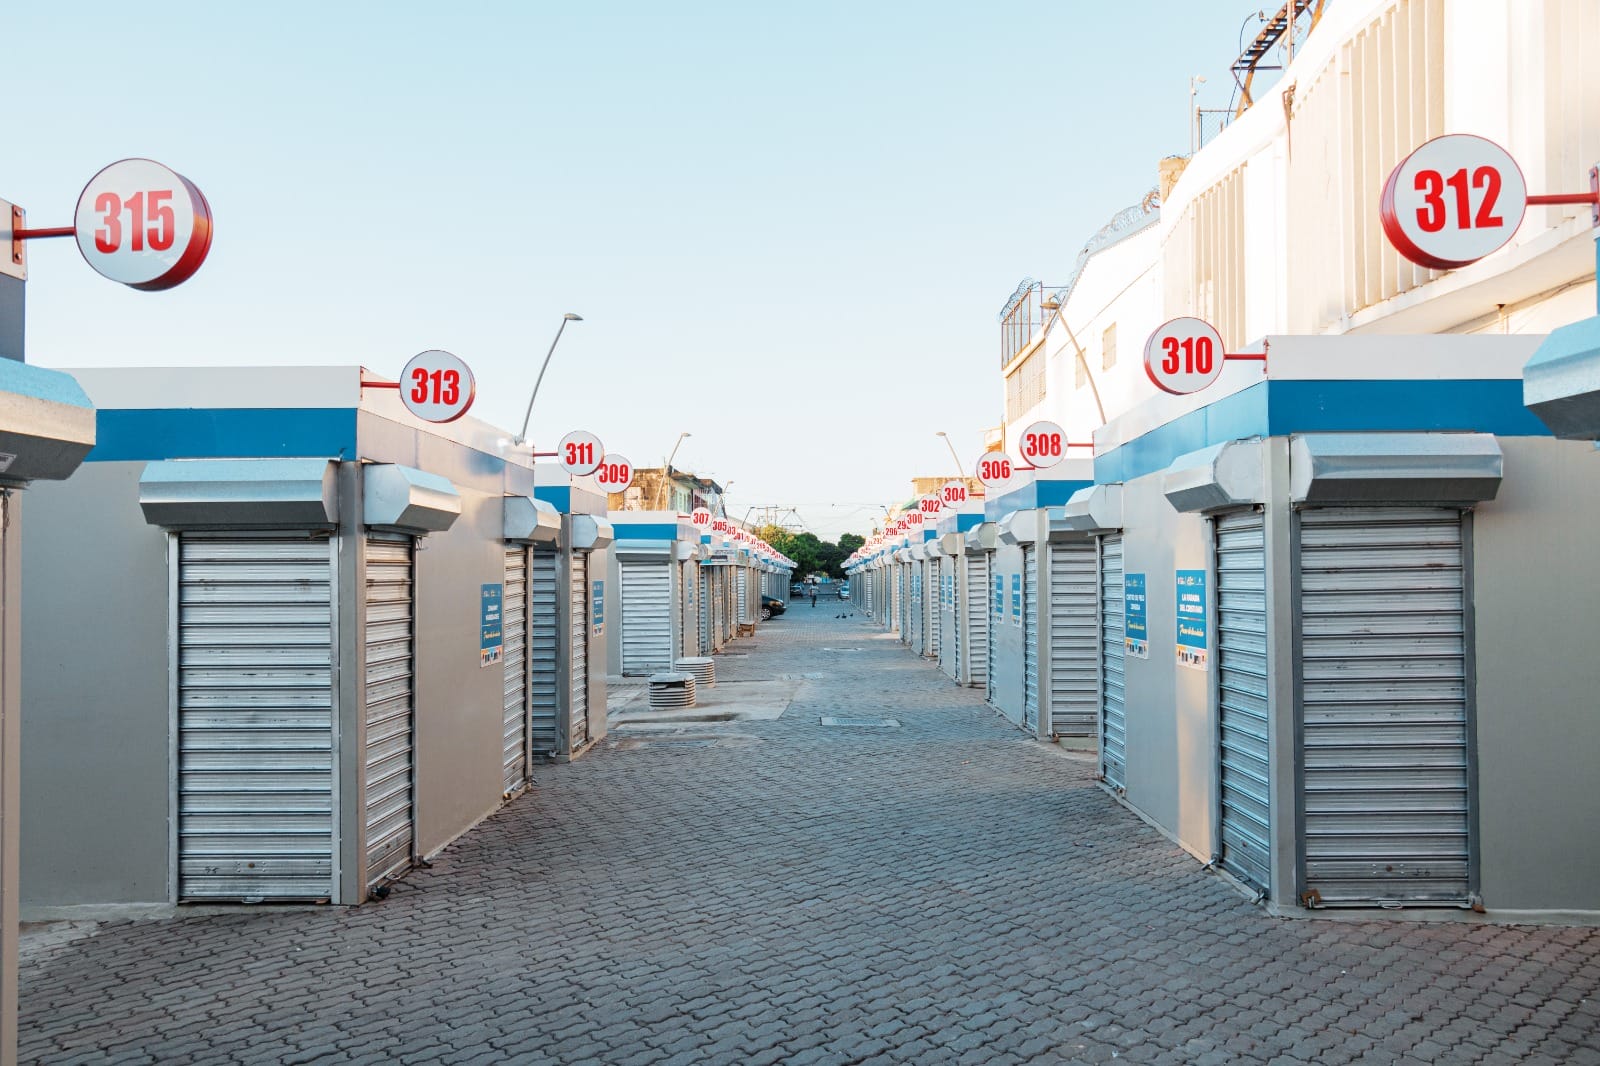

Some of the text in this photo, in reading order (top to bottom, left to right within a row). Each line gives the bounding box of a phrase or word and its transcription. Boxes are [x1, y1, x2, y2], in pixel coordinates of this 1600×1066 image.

[1413, 165, 1503, 233] 312
[94, 189, 175, 253] 315
[1161, 336, 1213, 375] 310
[411, 367, 460, 405] 313
[565, 442, 593, 466] 311
[1026, 433, 1061, 457] 308
[598, 464, 629, 484] 309
[981, 460, 1011, 480] 306
[944, 487, 966, 502] 304
[921, 499, 940, 513] 302
[693, 512, 709, 524] 307
[712, 521, 727, 532] 305
[906, 513, 923, 525] 300
